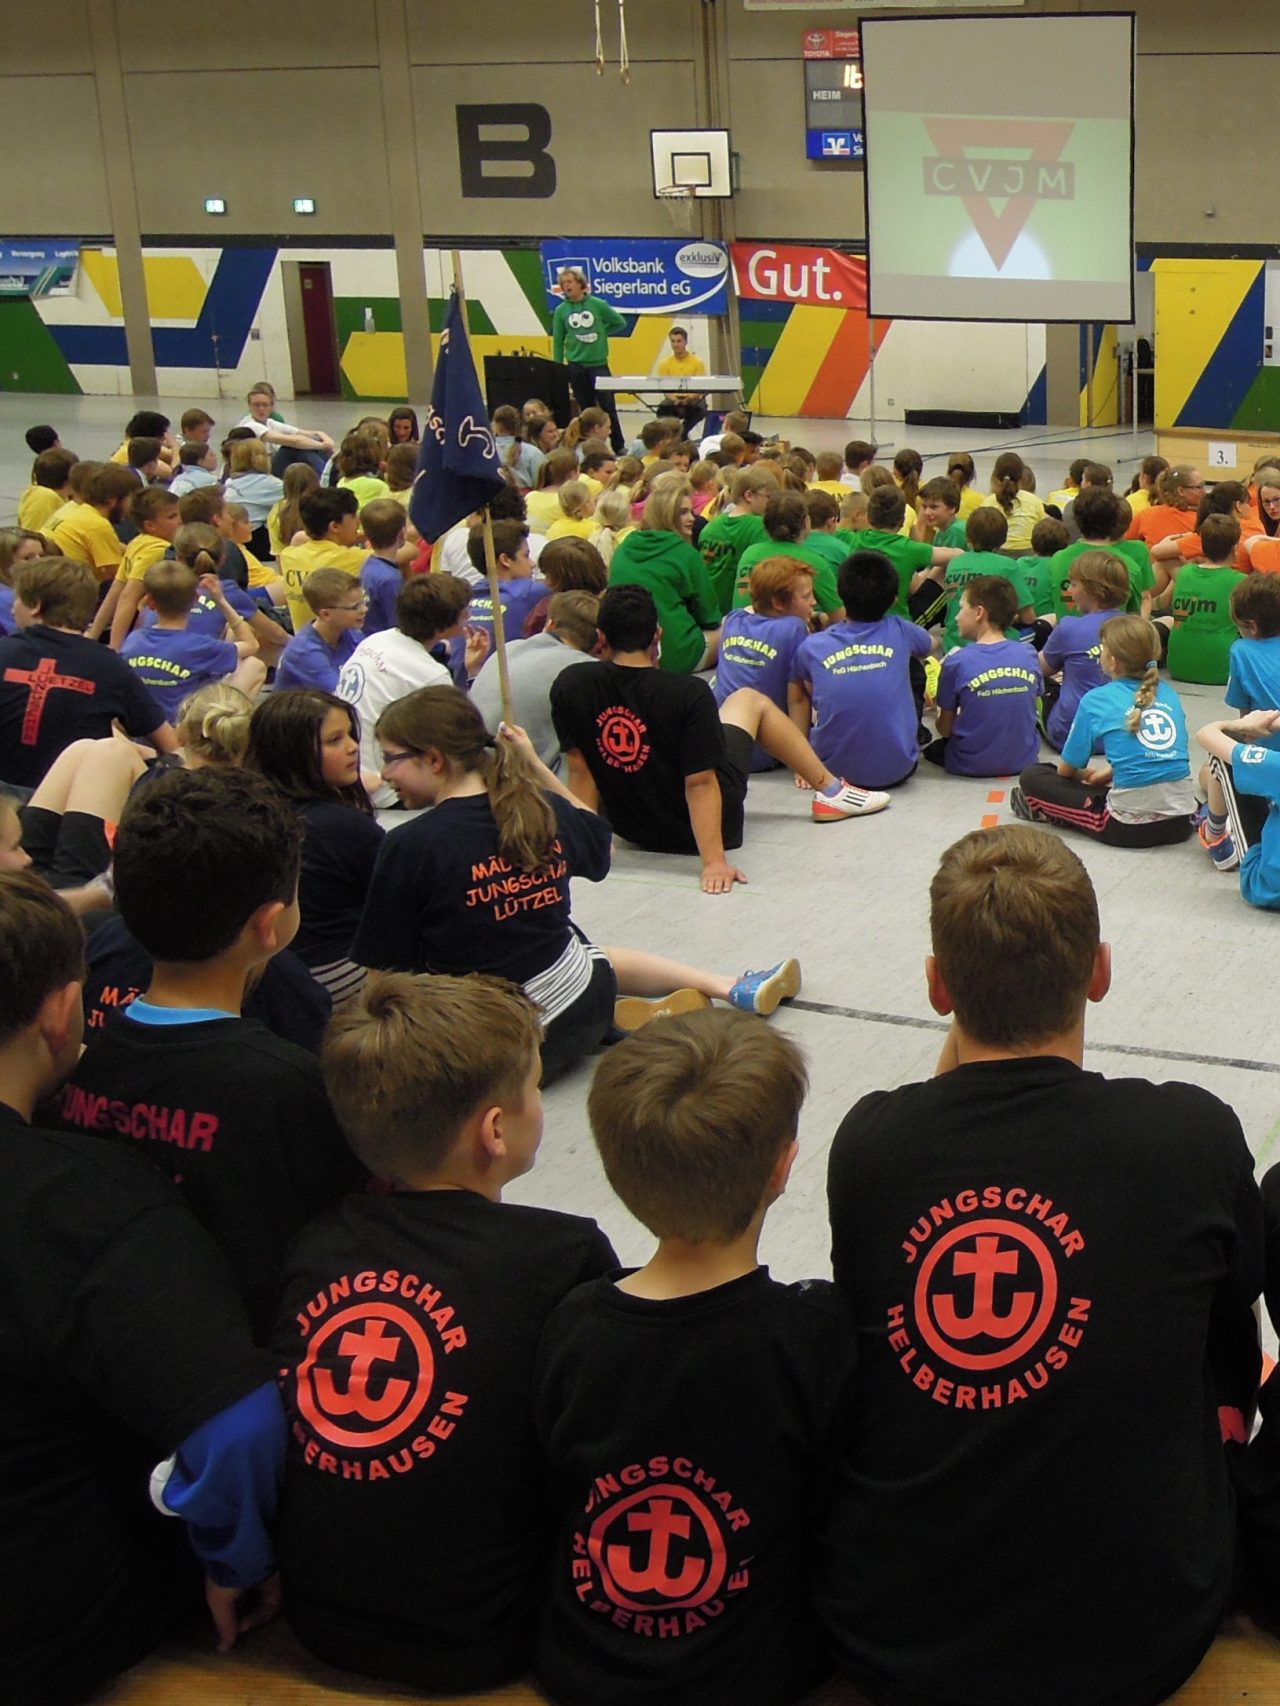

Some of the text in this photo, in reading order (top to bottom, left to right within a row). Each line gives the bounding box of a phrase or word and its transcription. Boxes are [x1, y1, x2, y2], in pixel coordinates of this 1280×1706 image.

[812, 90, 841, 100] HEIM
[455, 102, 557, 198] B
[932, 162, 1068, 195] CVJM
[592, 257, 665, 273] Volksbank
[593, 278, 692, 298] Siegerland eG
[748, 249, 843, 301] Gut.
[821, 644, 894, 670] JUNGSCHAR
[900, 1185, 1086, 1264] JUNGSCHAR
[296, 1269, 468, 1354] JUNGSCHAR
[887, 1296, 1092, 1410] HELBERHAUSEN
[294, 1391, 469, 1481] ERHAUSEN
